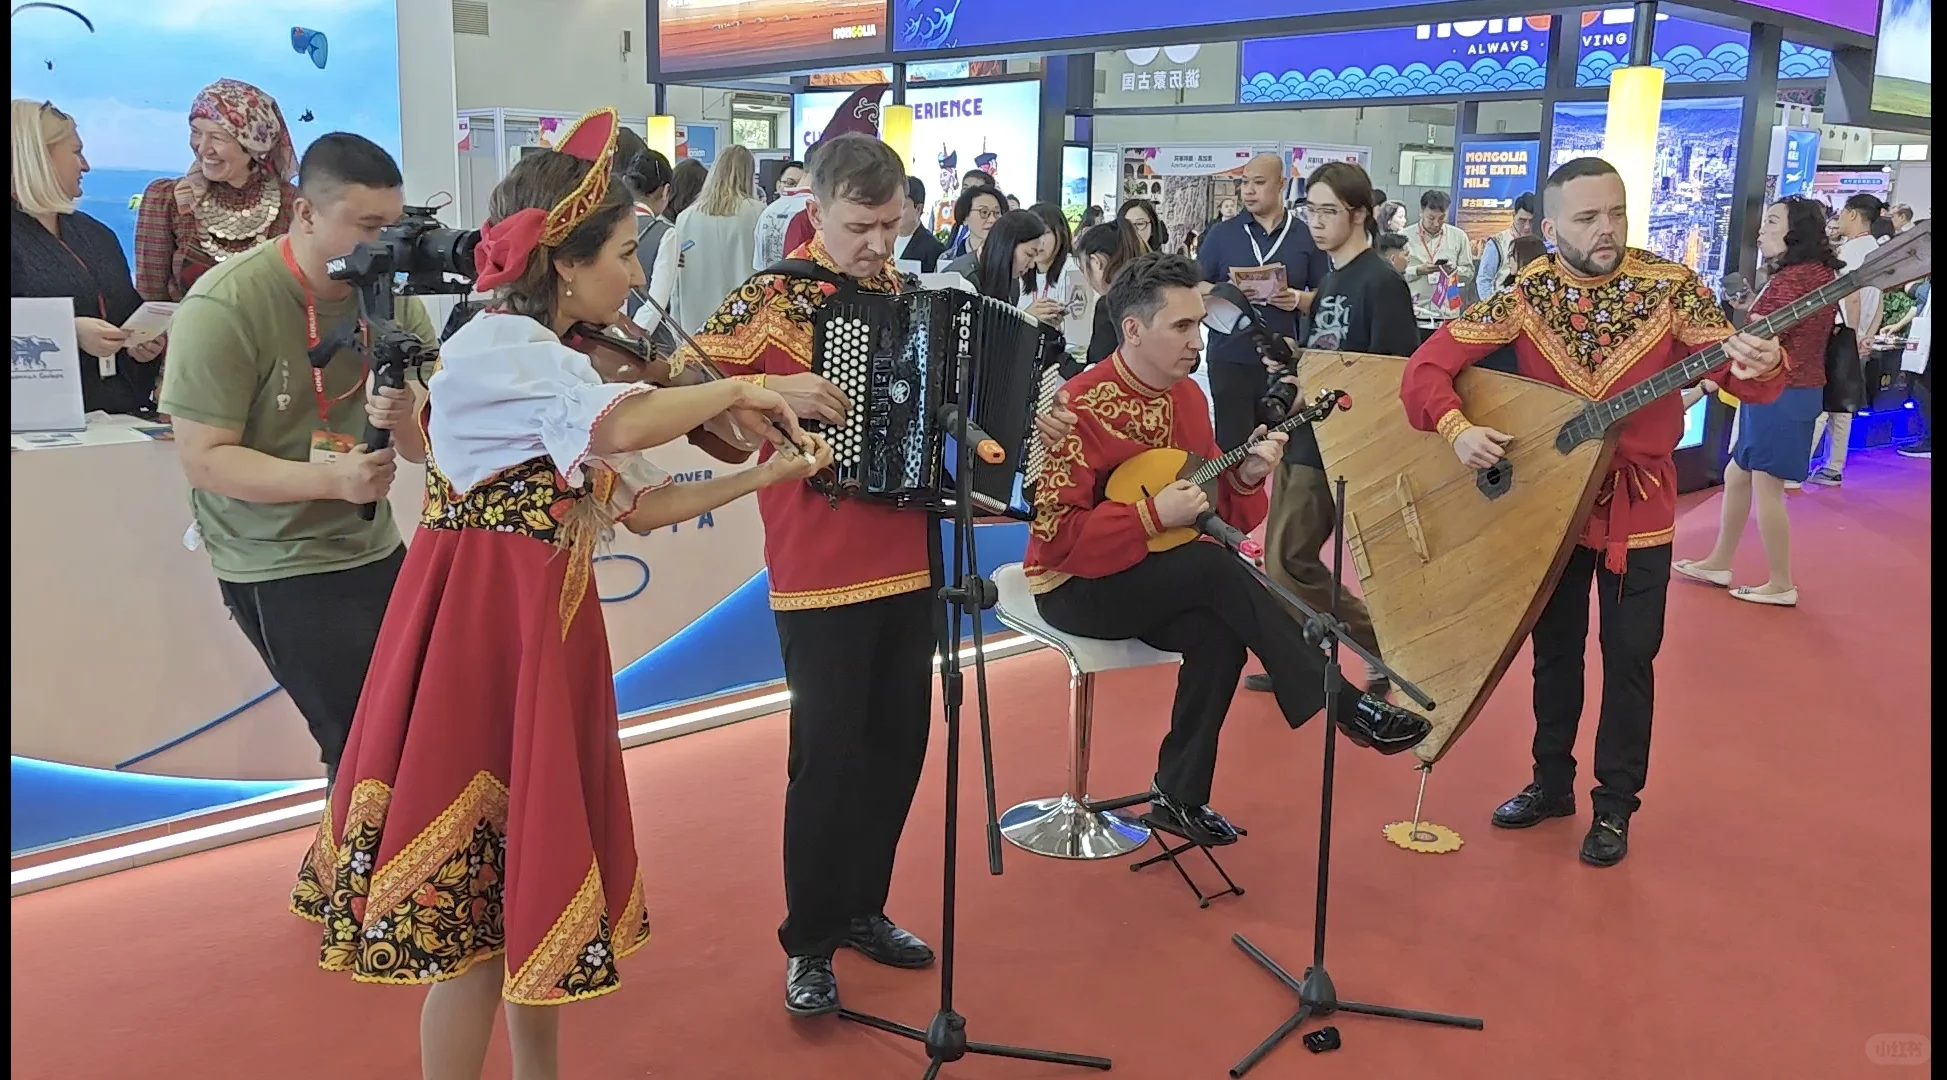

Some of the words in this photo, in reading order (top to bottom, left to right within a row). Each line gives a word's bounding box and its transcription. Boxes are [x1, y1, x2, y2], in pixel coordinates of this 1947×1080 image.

[833, 24, 877, 40] MONGOLIA
[1467, 40, 1529, 55] ALWAYS
[1582, 32, 1628, 47] VING
[915, 98, 983, 120] ERIENCE
[1465, 151, 1528, 163] MONGOLIA
[1464, 164, 1487, 176] THE
[1489, 164, 1527, 176] EXTRA
[1463, 177, 1491, 189] MILE
[674, 469, 713, 483] OVER
